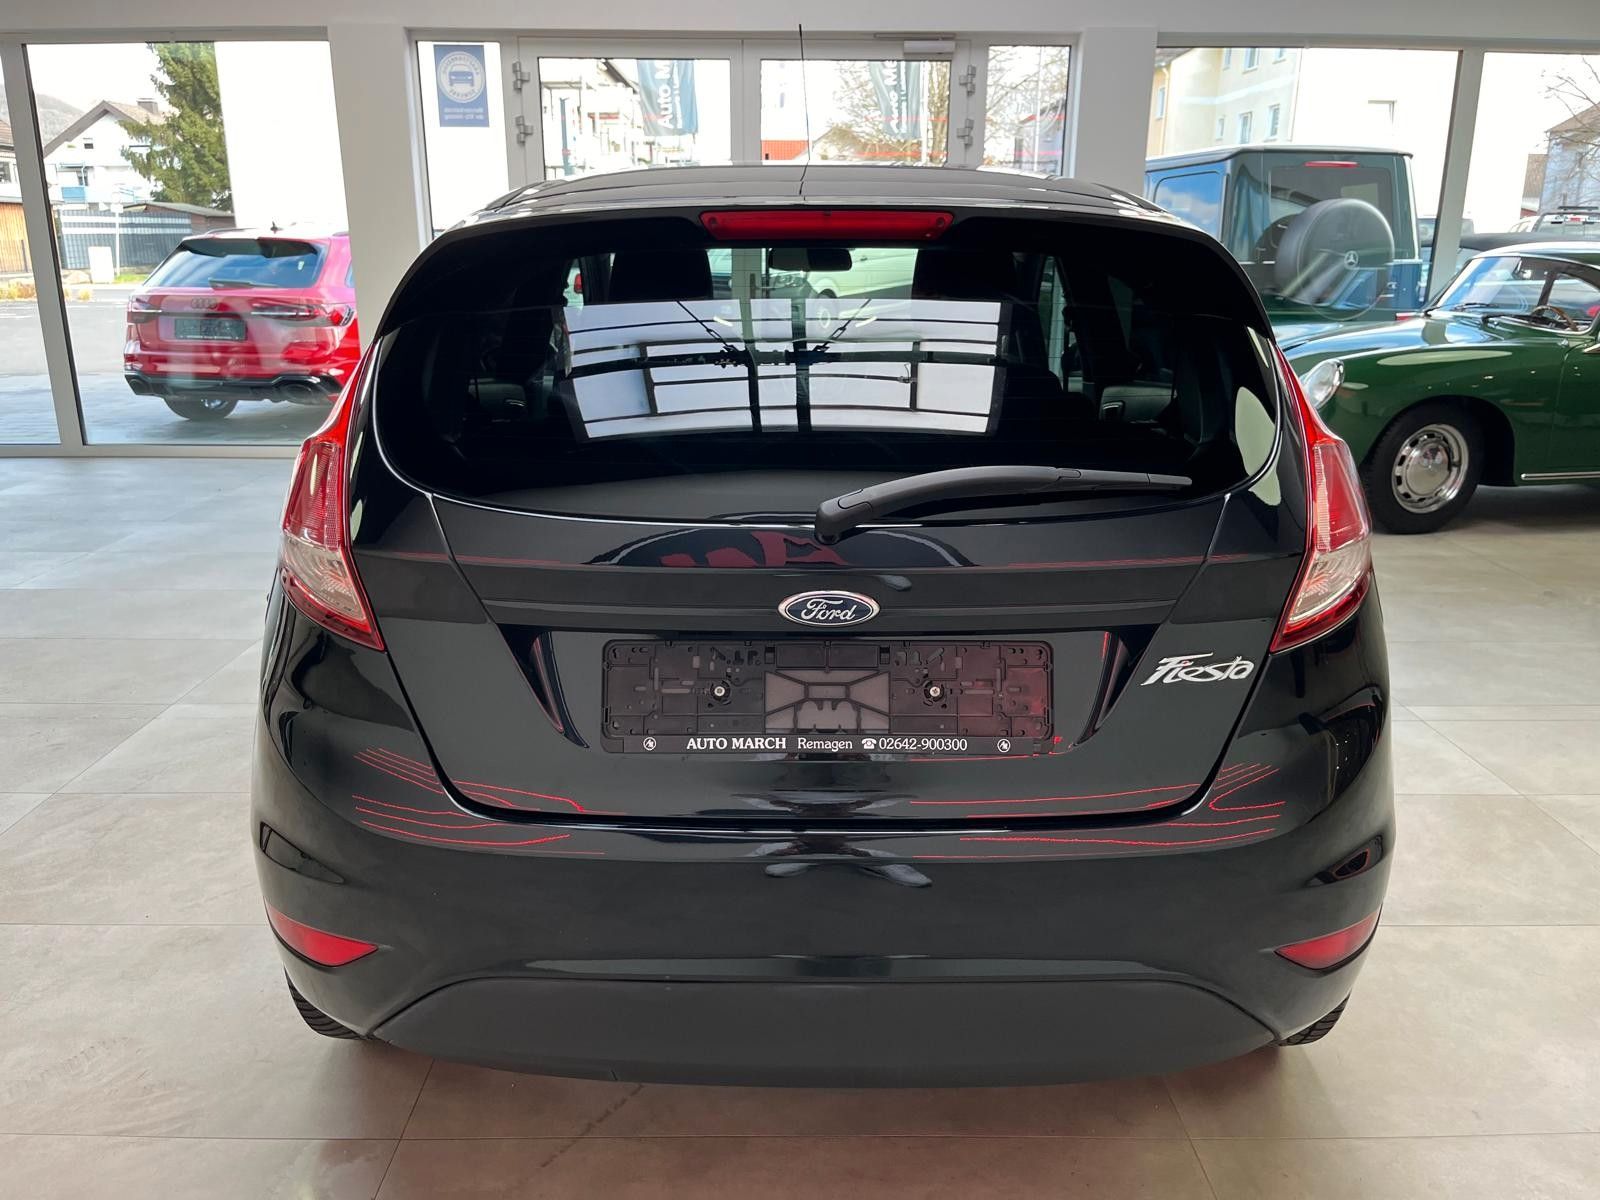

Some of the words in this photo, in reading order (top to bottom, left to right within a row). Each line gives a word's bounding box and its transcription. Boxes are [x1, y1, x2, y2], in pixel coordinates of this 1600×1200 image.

[656, 84, 674, 129] Auto
[801, 599, 857, 620] Ford
[1140, 652, 1255, 685] Fiesta
[686, 737, 728, 750] AUTO
[731, 737, 787, 750] MARCH
[797, 737, 853, 752] Remagen
[878, 738, 968, 751] 02642-900300
